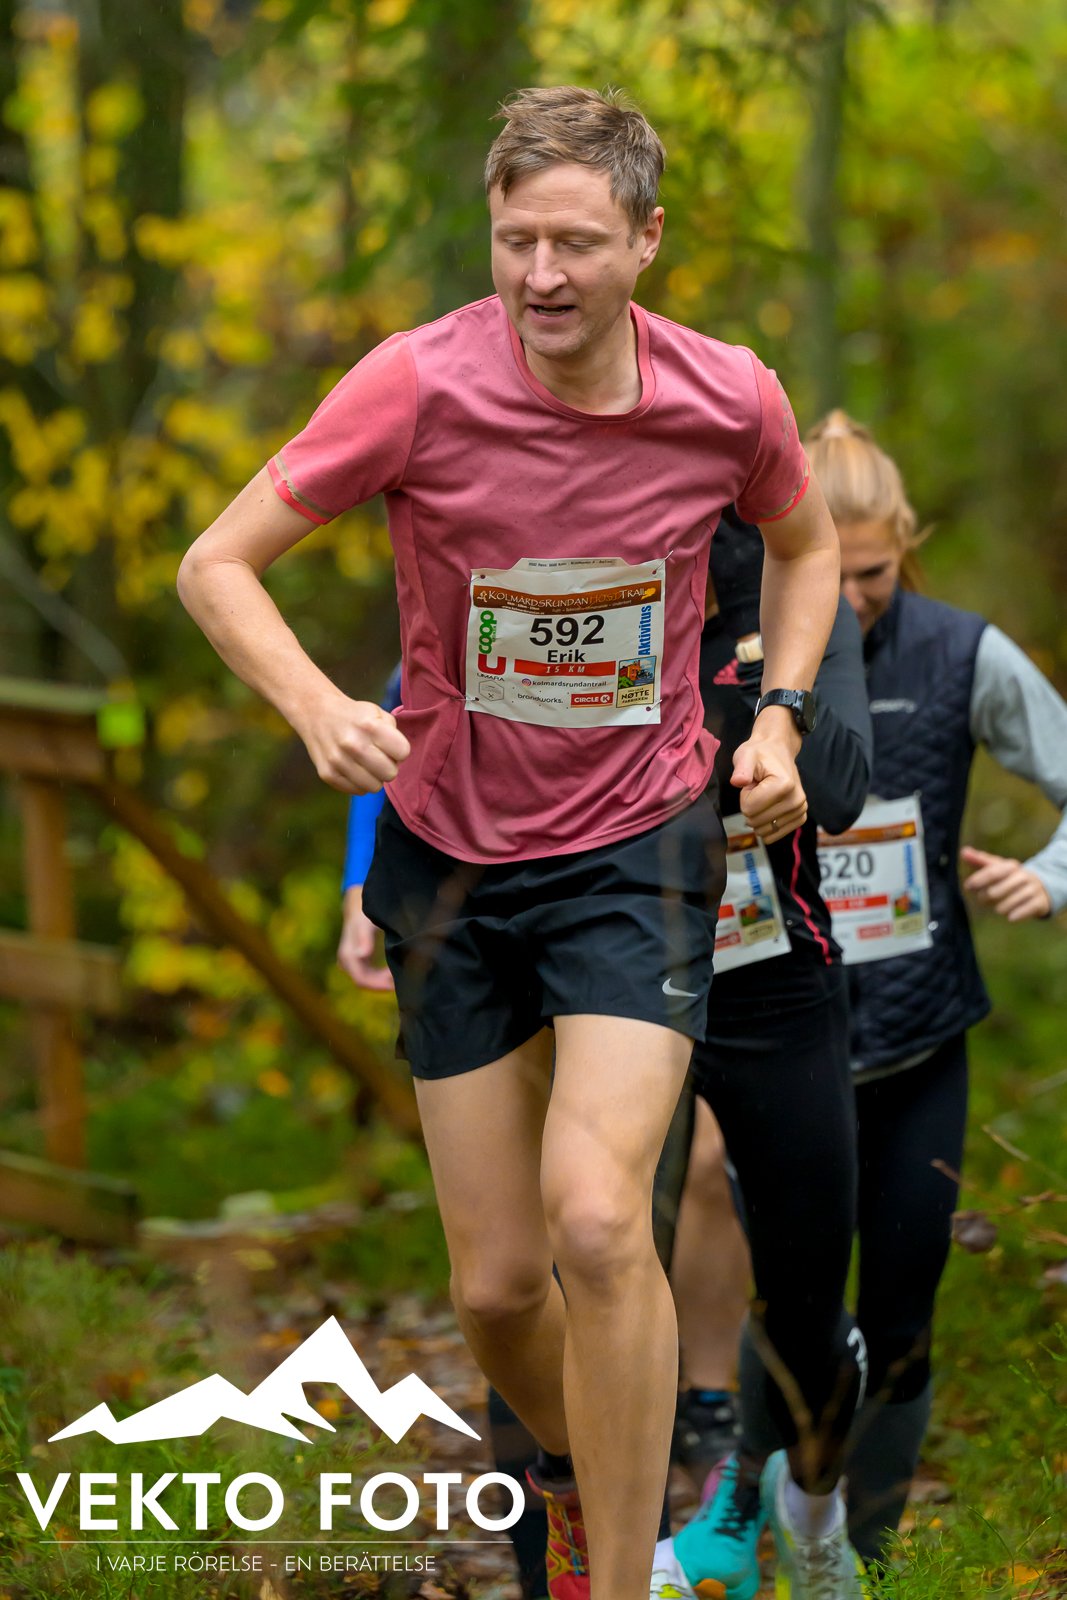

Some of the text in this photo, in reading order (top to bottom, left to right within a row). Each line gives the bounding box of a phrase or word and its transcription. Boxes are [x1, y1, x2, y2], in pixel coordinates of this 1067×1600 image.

[479, 610, 497, 654] coop
[529, 615, 605, 646] 592
[638, 605, 652, 655] Aktivitus
[547, 649, 586, 663] Erik
[568, 665, 585, 673] KM
[621, 689, 650, 700] NØTTE
[817, 850, 875, 880] 520
